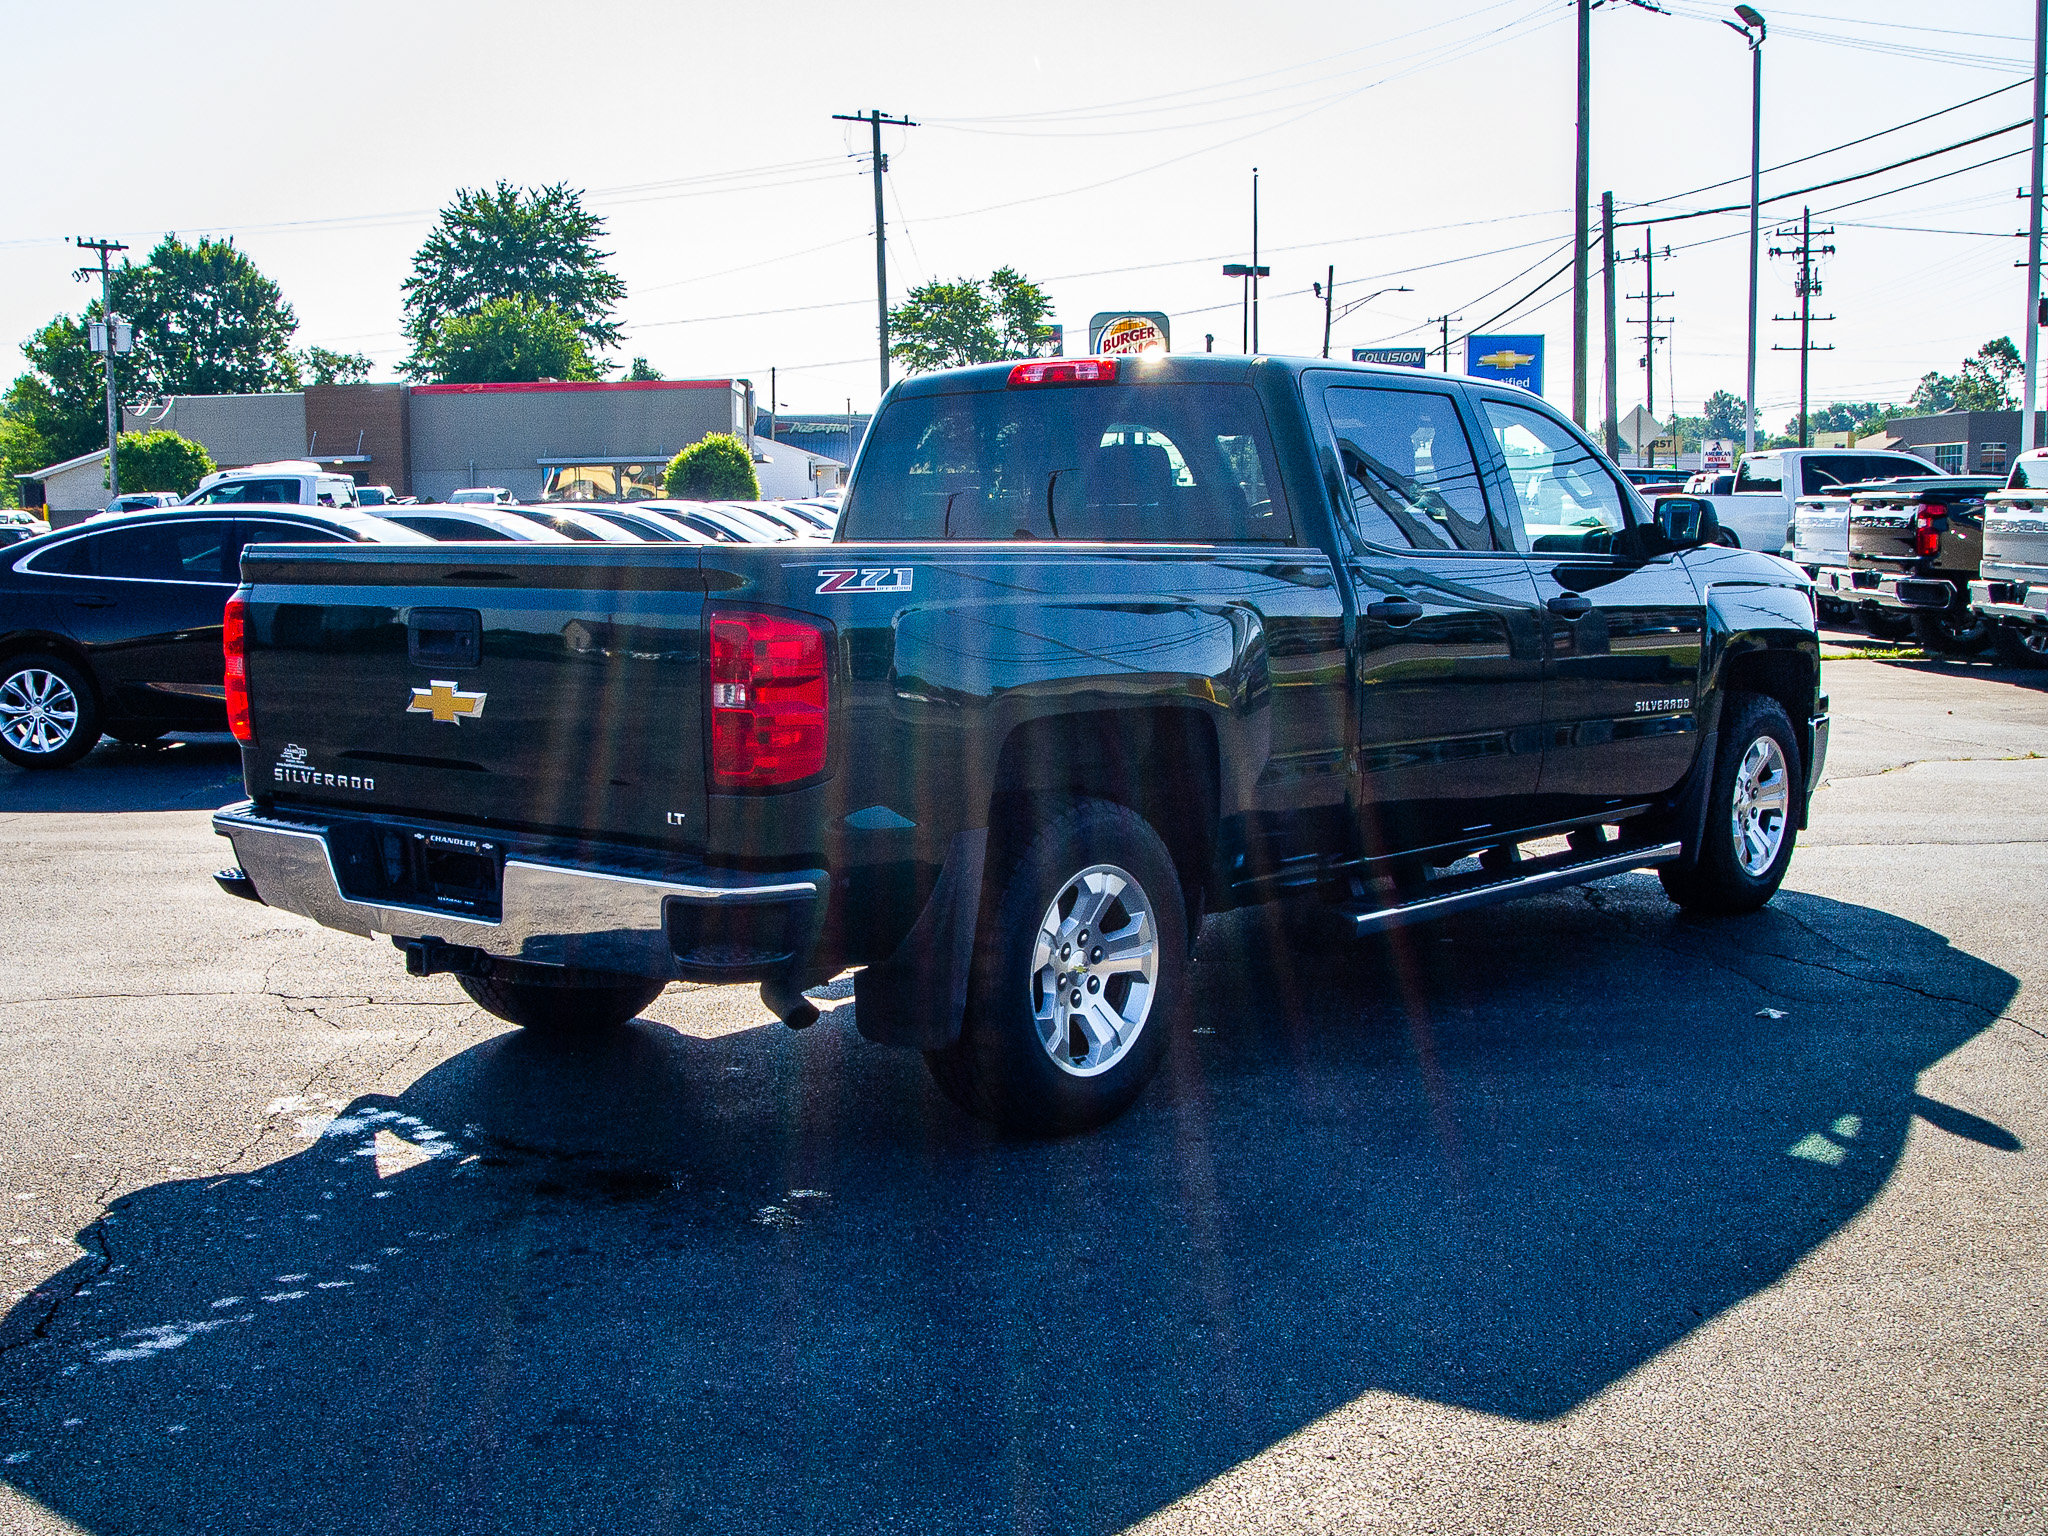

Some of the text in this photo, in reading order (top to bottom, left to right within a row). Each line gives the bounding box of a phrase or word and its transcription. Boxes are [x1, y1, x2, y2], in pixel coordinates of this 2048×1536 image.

[1103, 326, 1156, 354] BURGER
[1356, 352, 1422, 363] COLLISION
[815, 567, 914, 595] Z71
[1634, 698, 1690, 712] SILVERADO
[274, 767, 375, 791] SILVERADO
[667, 811, 685, 825] LT
[429, 834, 477, 848] CHANDLER
